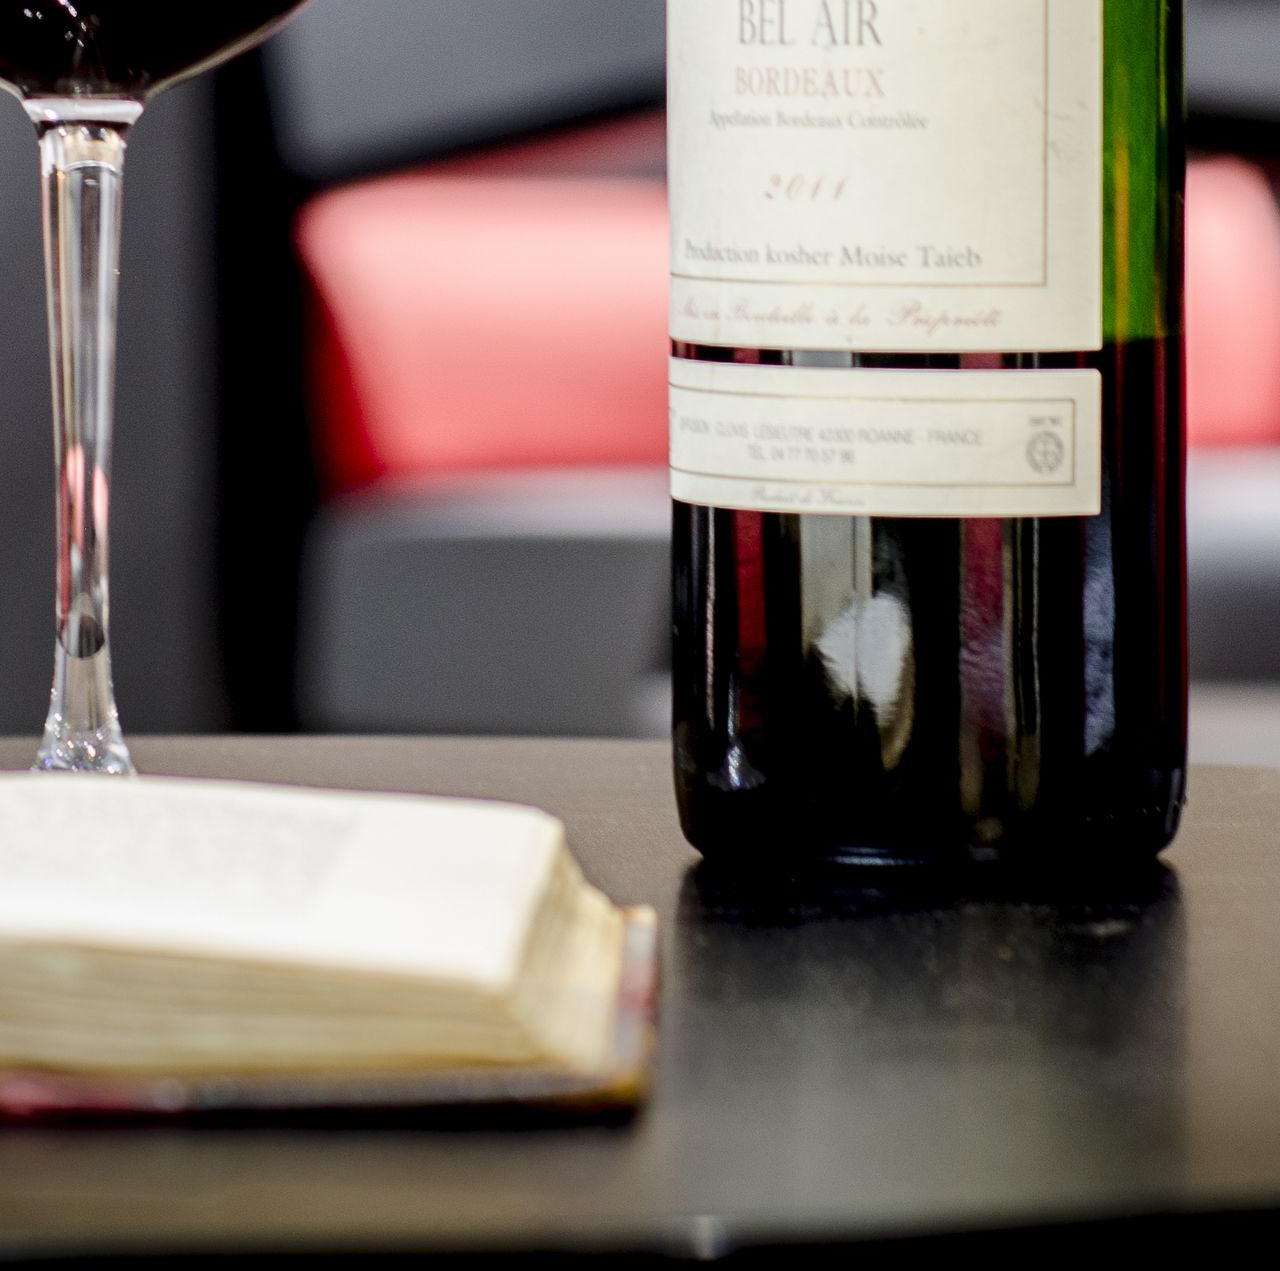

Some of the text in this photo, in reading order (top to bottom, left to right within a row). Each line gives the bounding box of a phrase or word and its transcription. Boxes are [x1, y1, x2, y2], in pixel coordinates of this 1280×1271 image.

[734, 66, 887, 98] BORDEAUX
[776, 110, 844, 129] Bordeaux
[763, 173, 850, 201] 2011
[685, 238, 759, 265] Production
[766, 240, 832, 267] kosher
[918, 245, 982, 269] Taieb
[927, 428, 983, 447] FRANCE
